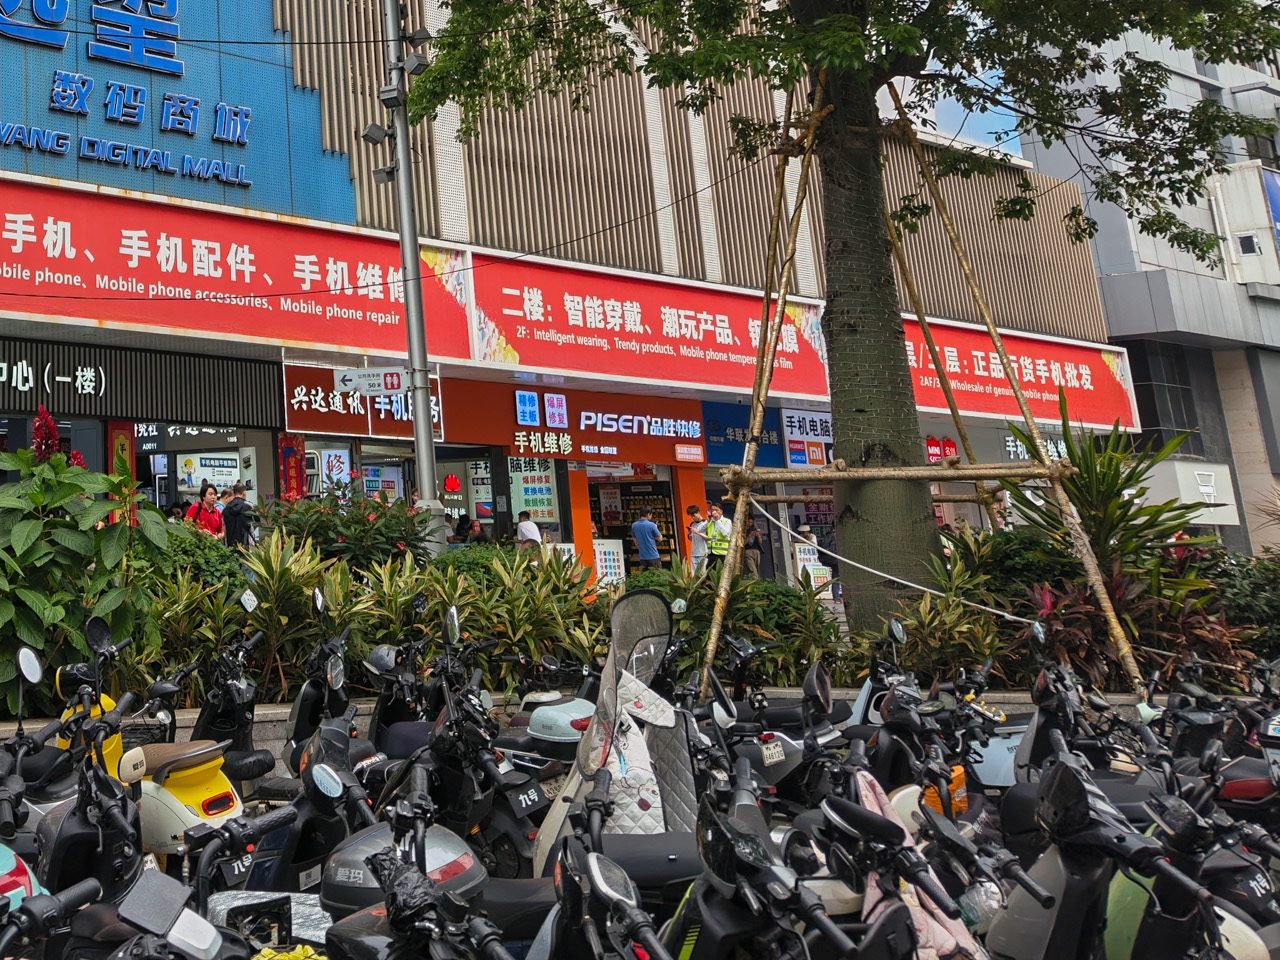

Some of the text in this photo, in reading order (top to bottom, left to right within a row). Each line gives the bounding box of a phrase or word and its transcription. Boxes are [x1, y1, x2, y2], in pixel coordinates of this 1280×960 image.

[49, 69, 253, 146] 数码商城
[79, 136, 179, 174] DIGITAL
[182, 153, 253, 187] MALL
[95, 274, 145, 294] Mobile
[148, 282, 192, 302] phone
[280, 297, 323, 316] Mobile
[326, 304, 363, 322] phone
[366, 309, 400, 326] repair
[502, 286, 800, 355] 二楼：智能穿戴、潮玩产品、钢膜
[533, 327, 575, 347] Intelligent
[614, 337, 640, 354] Trendy
[680, 345, 705, 359] Mobile
[706, 351, 728, 363] phone
[729, 354, 758, 366] tempere
[779, 357, 793, 370] film
[920, 375, 941, 389] 2AF/3
[951, 379, 985, 393] Wholesale
[985, 384, 993, 393] of
[993, 386, 1016, 398] genuin
[290, 385, 365, 416] 兴达通讯
[520, 410, 537, 422] 主板
[549, 412, 566, 425] 修复
[579, 411, 702, 438] PISEN 品胜快修
[785, 415, 833, 438] 手机电脑
[142, 442, 157, 450] A0011
[514, 432, 573, 455] 手机维修
[725, 426, 779, 446] 华联发合楼
[326, 453, 345, 476] 修
[523, 486, 552, 496] 更换电池
[524, 497, 553, 508] 数据恢复
[518, 788, 539, 808] 九号
[231, 854, 252, 875] 九号
[335, 867, 364, 884] 爱玛
[1248, 873, 1271, 898] 九号
